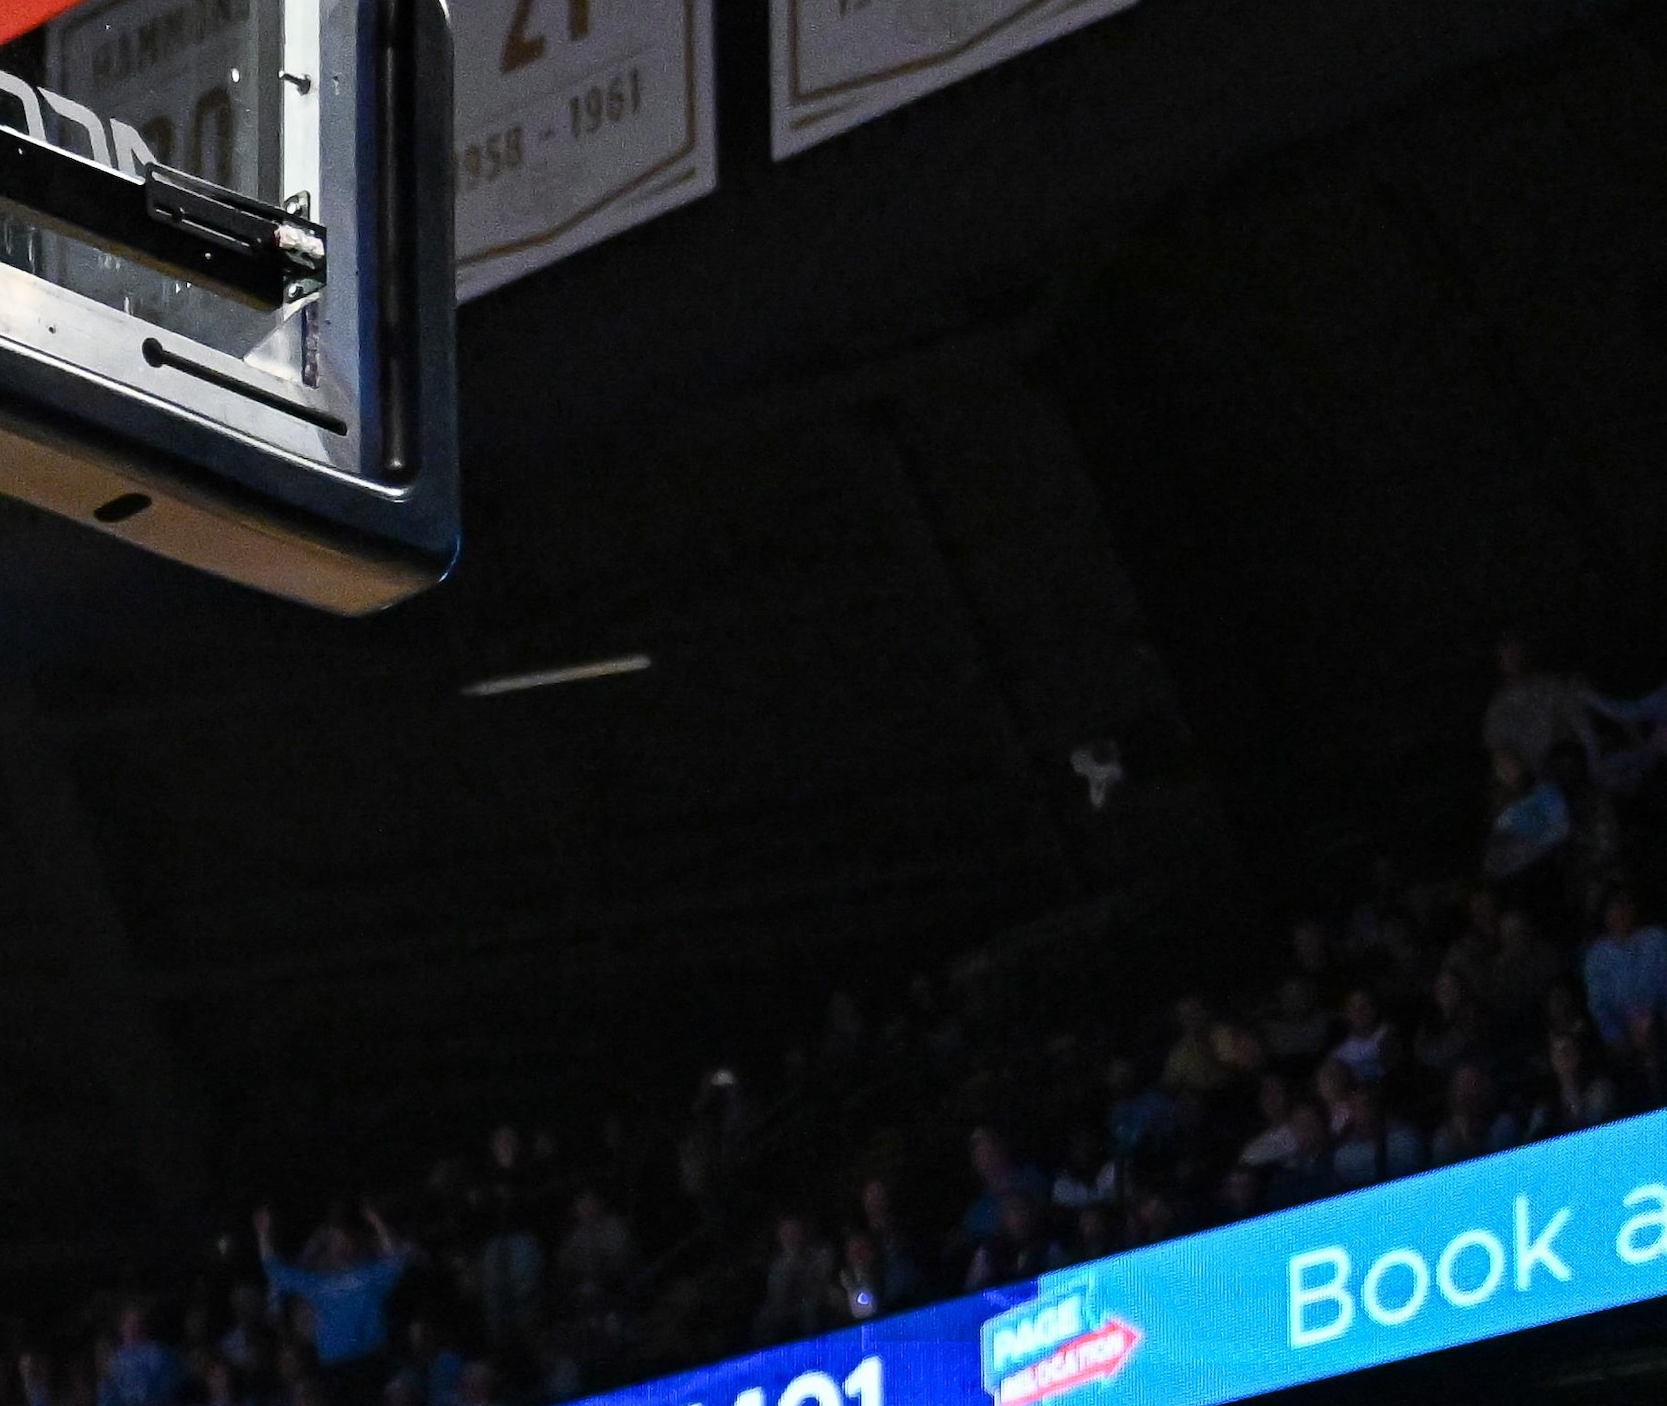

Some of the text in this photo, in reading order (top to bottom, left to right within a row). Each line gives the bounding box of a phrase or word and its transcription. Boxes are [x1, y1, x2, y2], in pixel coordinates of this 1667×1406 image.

[461, 124, 523, 191] 958
[569, 66, 643, 139] 1961
[1287, 1192, 1572, 1350] Book
